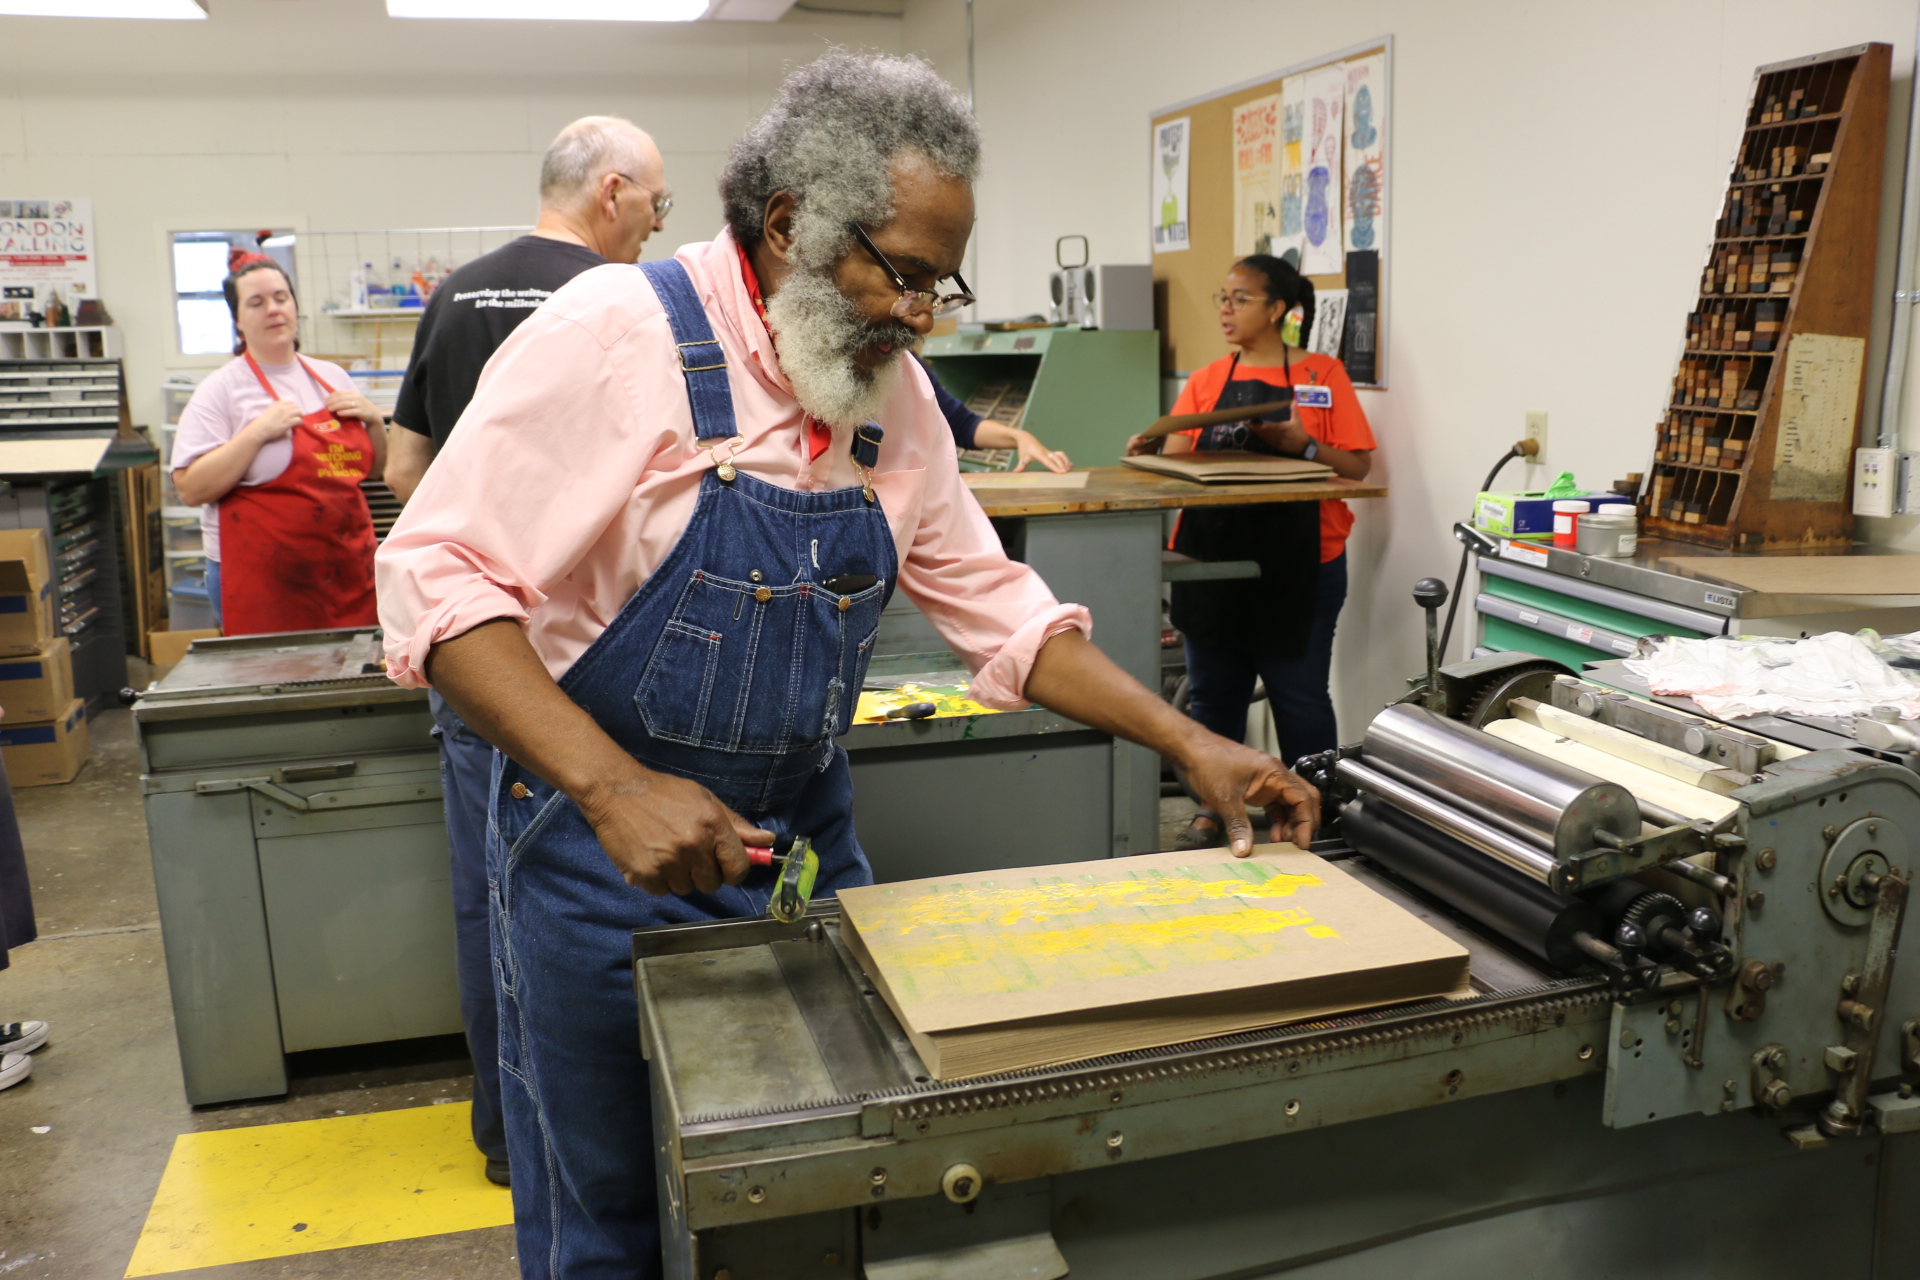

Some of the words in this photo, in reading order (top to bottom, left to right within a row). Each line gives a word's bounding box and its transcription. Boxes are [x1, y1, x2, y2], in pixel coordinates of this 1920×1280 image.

[1364, 152, 1383, 217] DANCE
[0, 221, 84, 236] ONDON
[0, 237, 85, 252] ALLING
[453, 288, 500, 302] Preserving
[501, 288, 517, 298] the
[488, 298, 505, 308] the
[1713, 595, 1734, 606] LISTA
